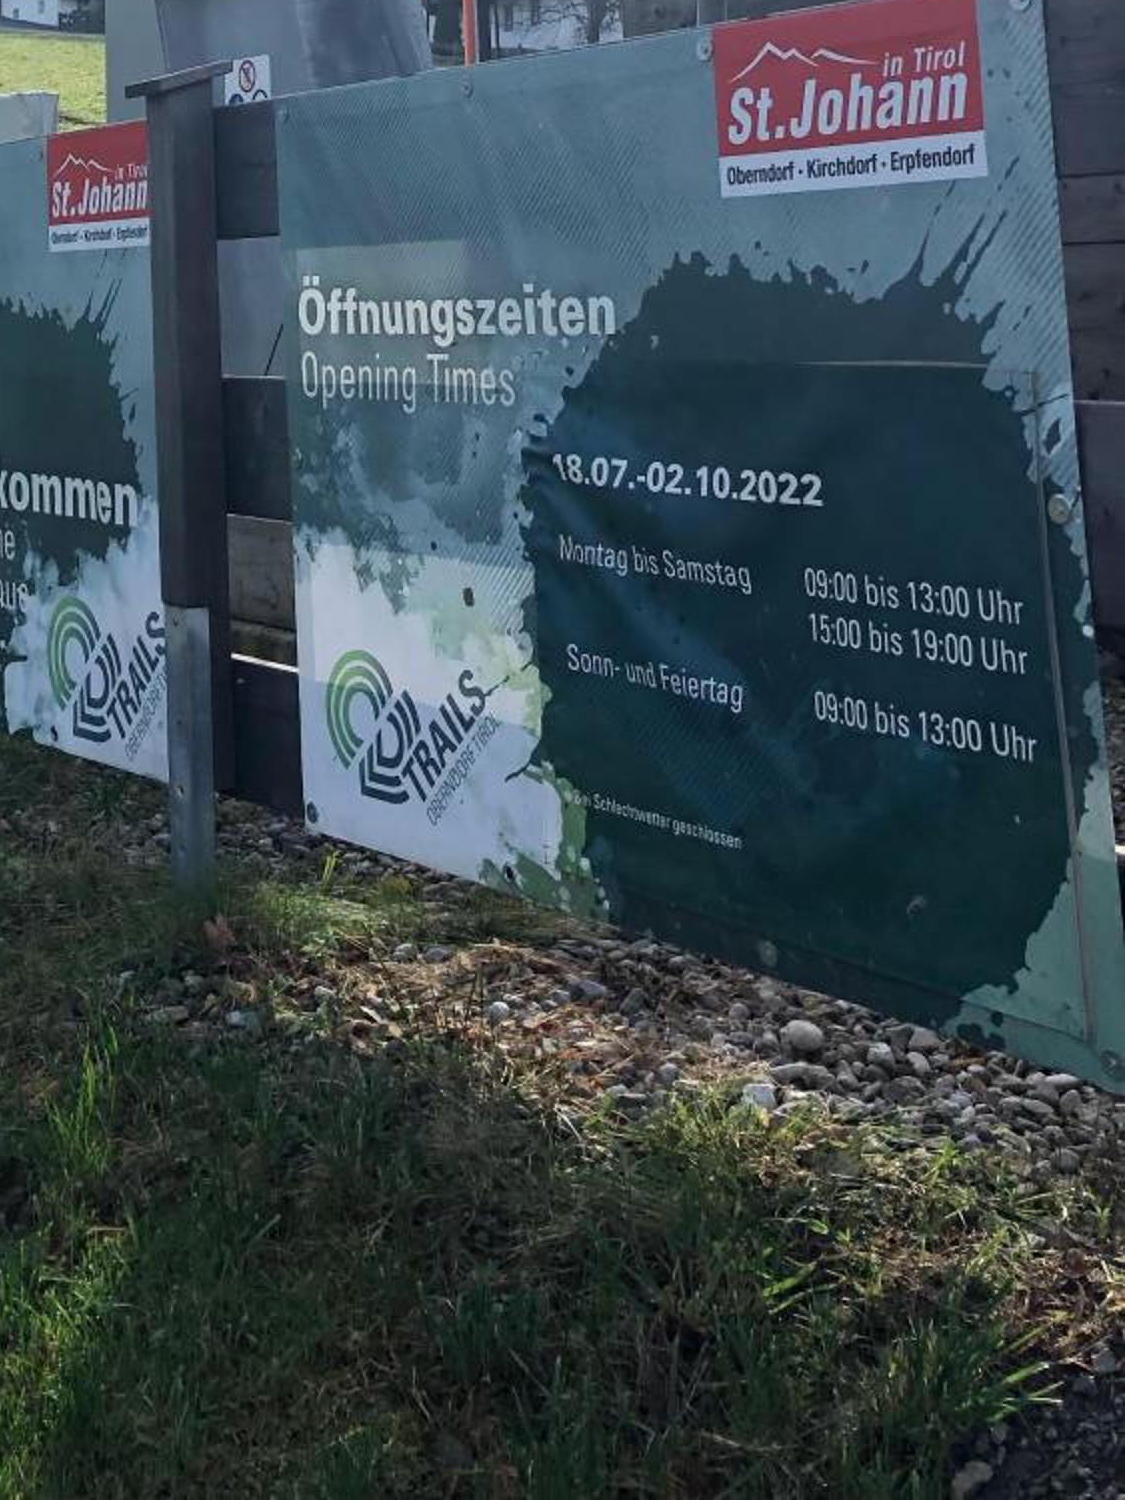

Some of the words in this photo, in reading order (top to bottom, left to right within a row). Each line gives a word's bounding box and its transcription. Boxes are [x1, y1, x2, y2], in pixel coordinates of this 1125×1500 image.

[882, 52, 904, 77] in
[914, 40, 966, 74] Tirol
[728, 71, 968, 146] St.Johann
[727, 160, 795, 186] Oberndorf
[807, 153, 878, 179] Kirchdorf
[890, 143, 976, 175] Erpfendorf
[298, 275, 616, 347] Öffnungszeiten
[301, 350, 417, 414] Opening
[426, 352, 516, 407] Times
[552, 453, 824, 507] 18.07.-02.10.2022
[559, 533, 628, 577] Montag
[632, 544, 660, 575] bis
[663, 549, 752, 595] Samstag
[804, 567, 858, 604] 09:00
[864, 574, 900, 609] bis
[907, 581, 970, 619] 13:00
[977, 587, 1024, 625] Uhr
[809, 613, 862, 649] 15:00
[868, 620, 903, 656] bis
[911, 628, 973, 667] 19:00
[981, 636, 1028, 675] Uhr
[566, 643, 620, 678] Sonn-
[625, 661, 657, 689] und
[659, 663, 744, 714] Feiertag
[401, 668, 487, 803] TRAILS
[814, 691, 868, 730] 09:00
[874, 701, 910, 738] bis
[919, 711, 982, 752] 13:00
[990, 721, 1038, 763] Uhr
[673, 819, 742, 851] geschlossen
